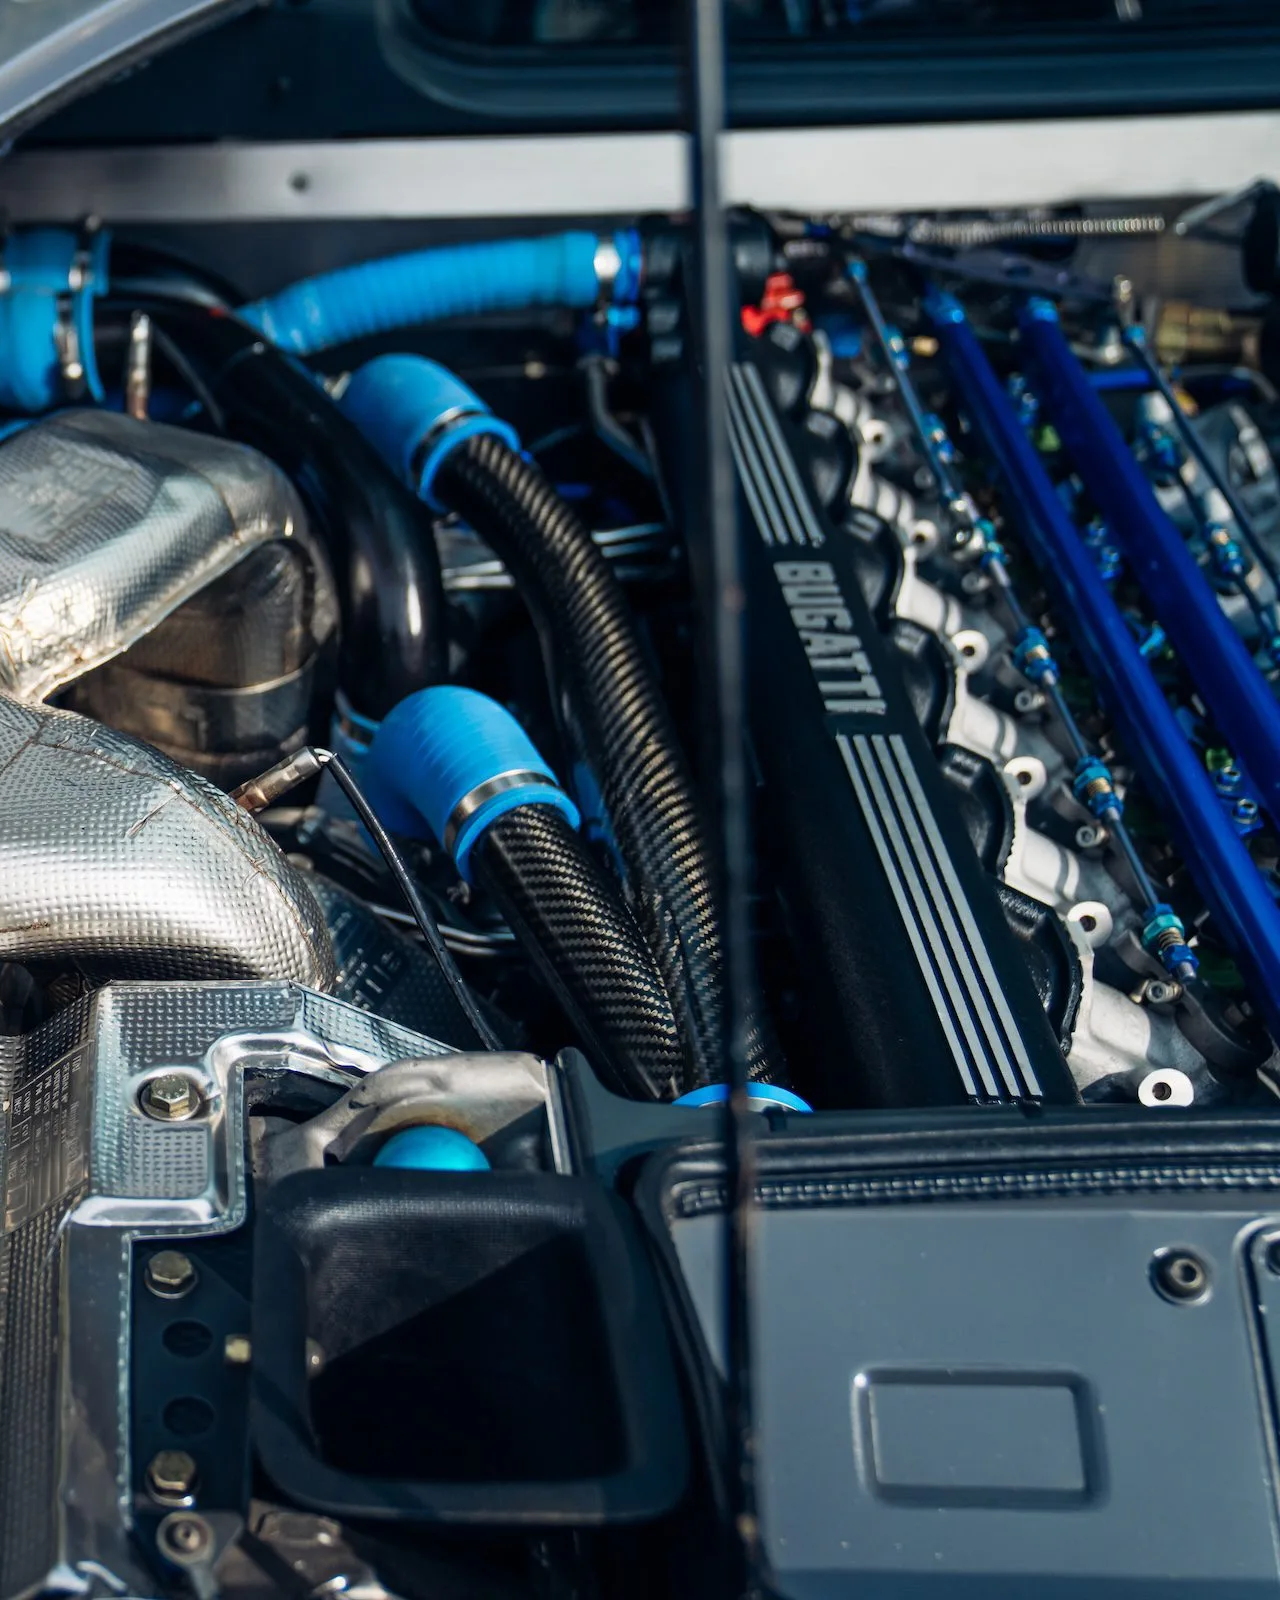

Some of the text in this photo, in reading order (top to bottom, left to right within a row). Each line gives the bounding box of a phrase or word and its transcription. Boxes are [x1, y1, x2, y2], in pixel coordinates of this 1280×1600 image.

[773, 561, 887, 715] BUGATTI
[52, 1069, 61, 1100] ORDER
[61, 1062, 70, 1093] SERIAL
